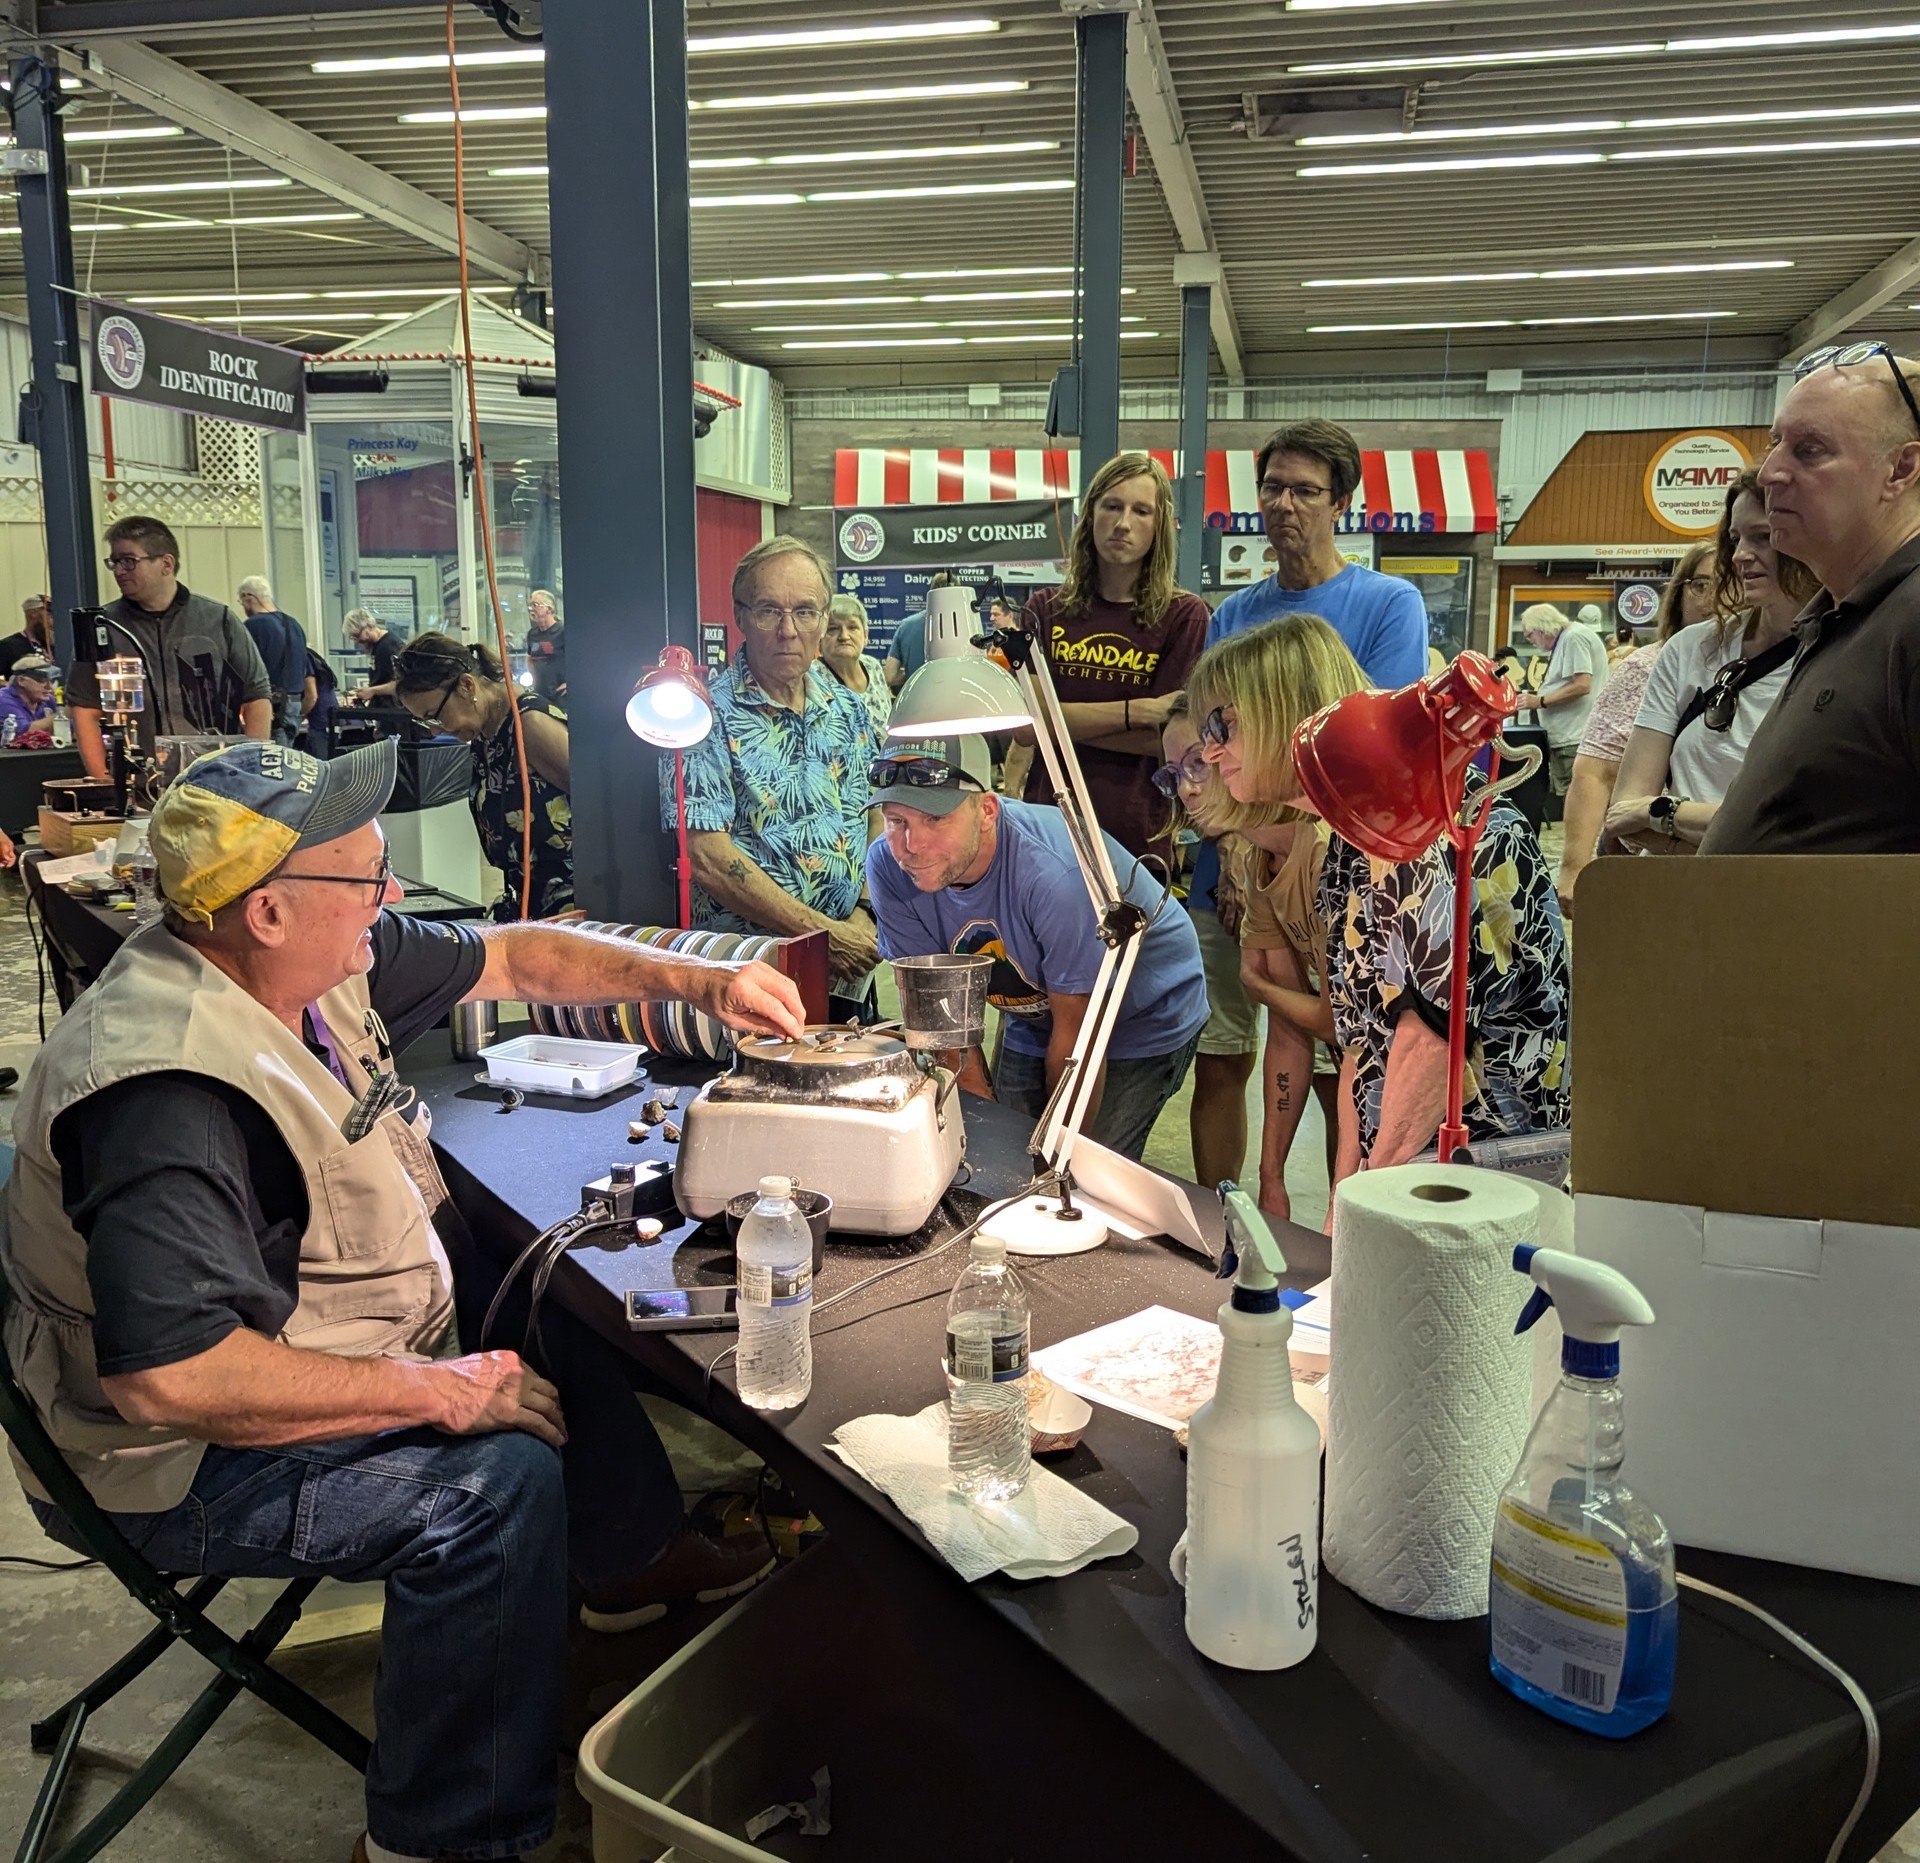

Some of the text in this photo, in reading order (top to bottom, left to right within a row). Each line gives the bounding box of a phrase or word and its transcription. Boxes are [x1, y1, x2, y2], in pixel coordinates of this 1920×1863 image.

[208, 350, 259, 381] ROCK
[160, 365, 296, 414] IDENTIFICATION
[347, 438, 419, 451] Princess Kay
[1656, 467, 1742, 487] MAMP
[1658, 501, 1699, 509] Organized
[912, 523, 1047, 544] KIDS' CORNER
[1595, 548, 1614, 556] See
[904, 573, 933, 585] Dairy
[1059, 665, 1151, 686] RCHESTRA
